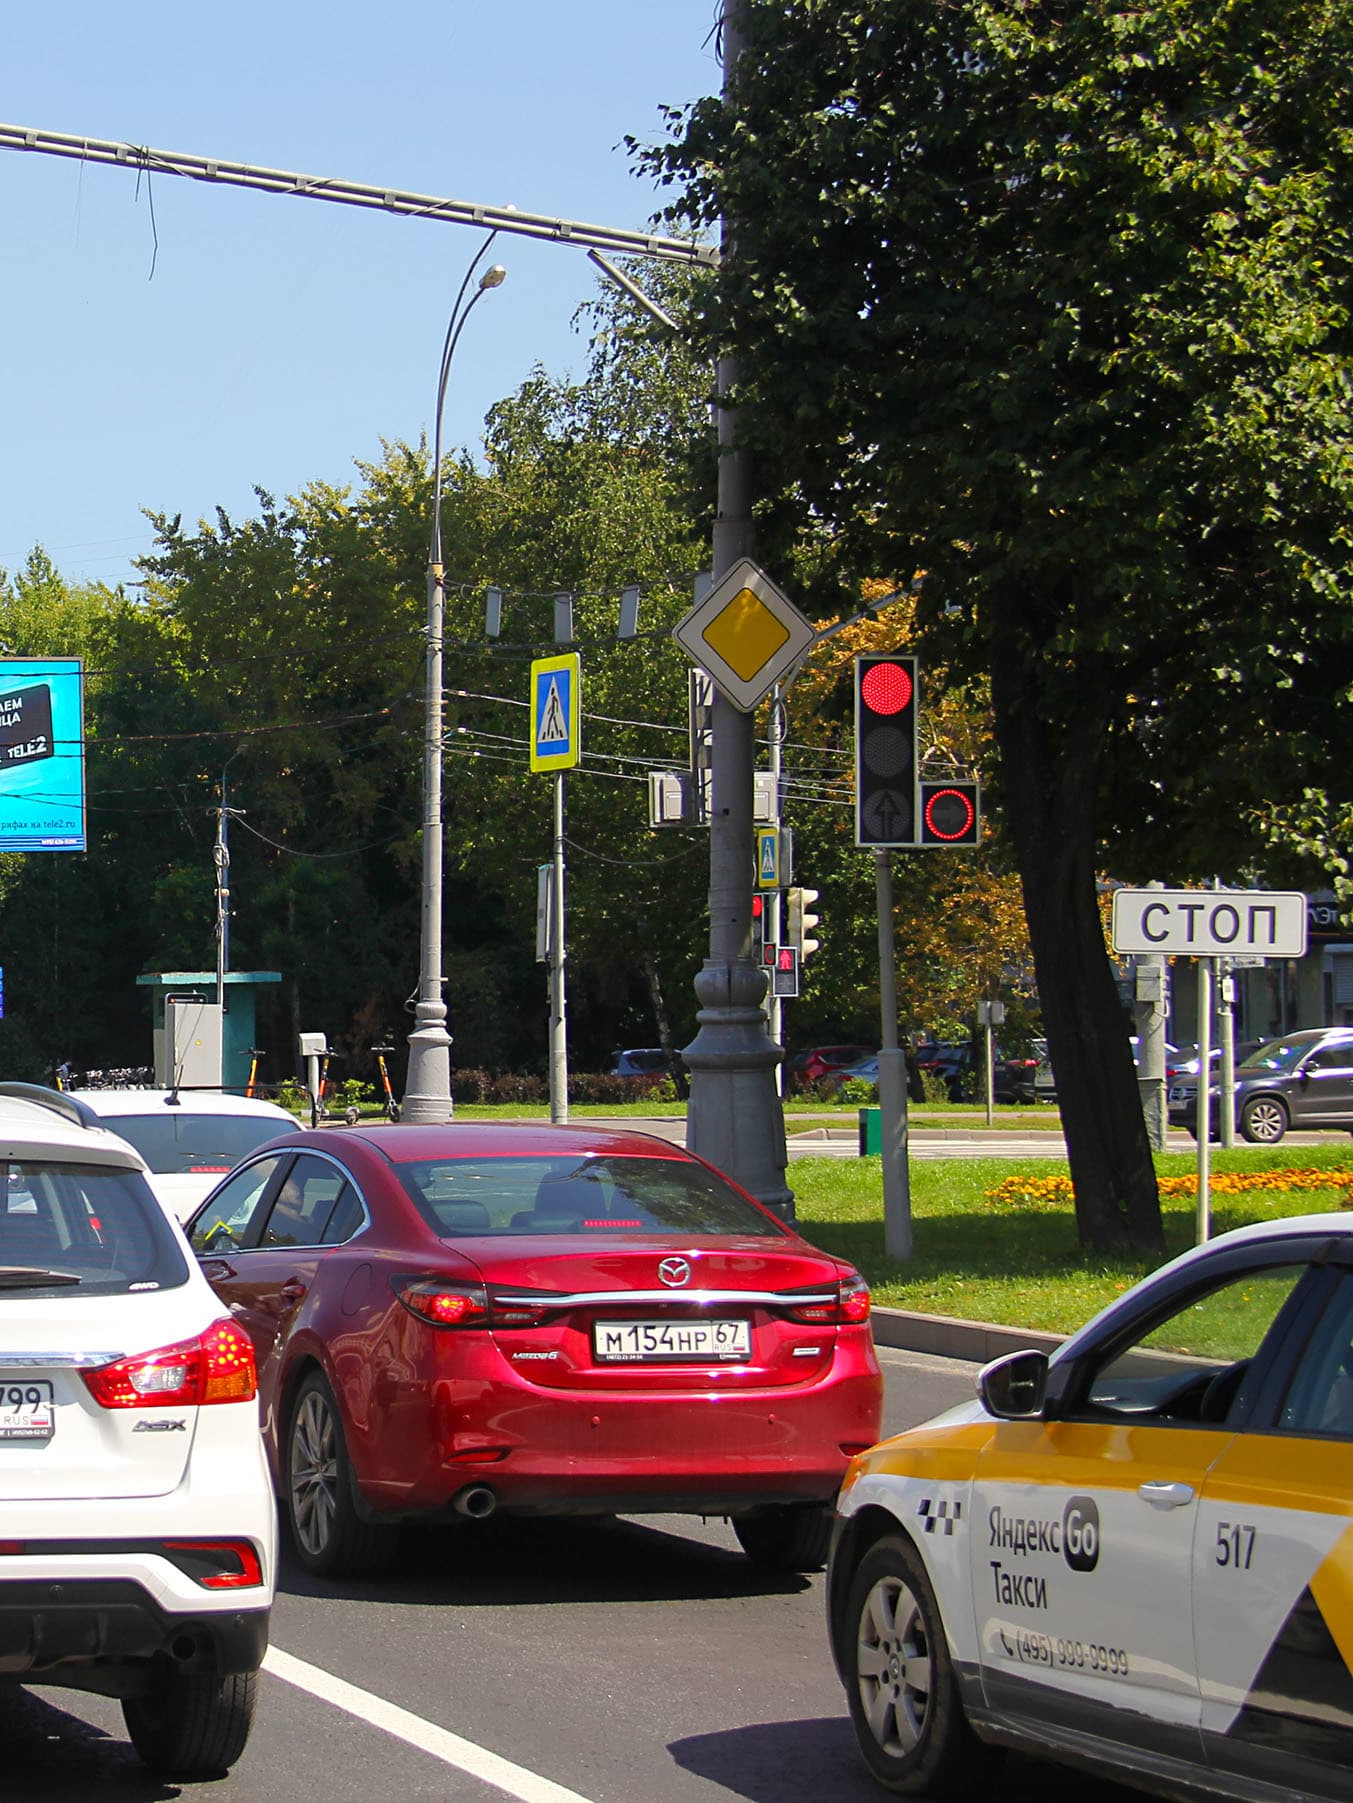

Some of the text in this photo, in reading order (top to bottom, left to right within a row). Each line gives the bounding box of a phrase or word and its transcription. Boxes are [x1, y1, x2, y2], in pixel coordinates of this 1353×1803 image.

[7, 735, 47, 758] TELE2
[30, 821, 41, 829] на
[43, 818, 76, 829] tele2.ru
[1140, 902, 1276, 945] СТОП
[714, 1344, 732, 1352] RUS
[715, 1322, 739, 1344] 67
[3, 1415, 30, 1425] RUS
[989, 1505, 1097, 1557] Яндекс Go
[1215, 1521, 1256, 1570] 517
[989, 1560, 1048, 1609] Такси
[1016, 1629, 1128, 1677] (495) 999-9999
